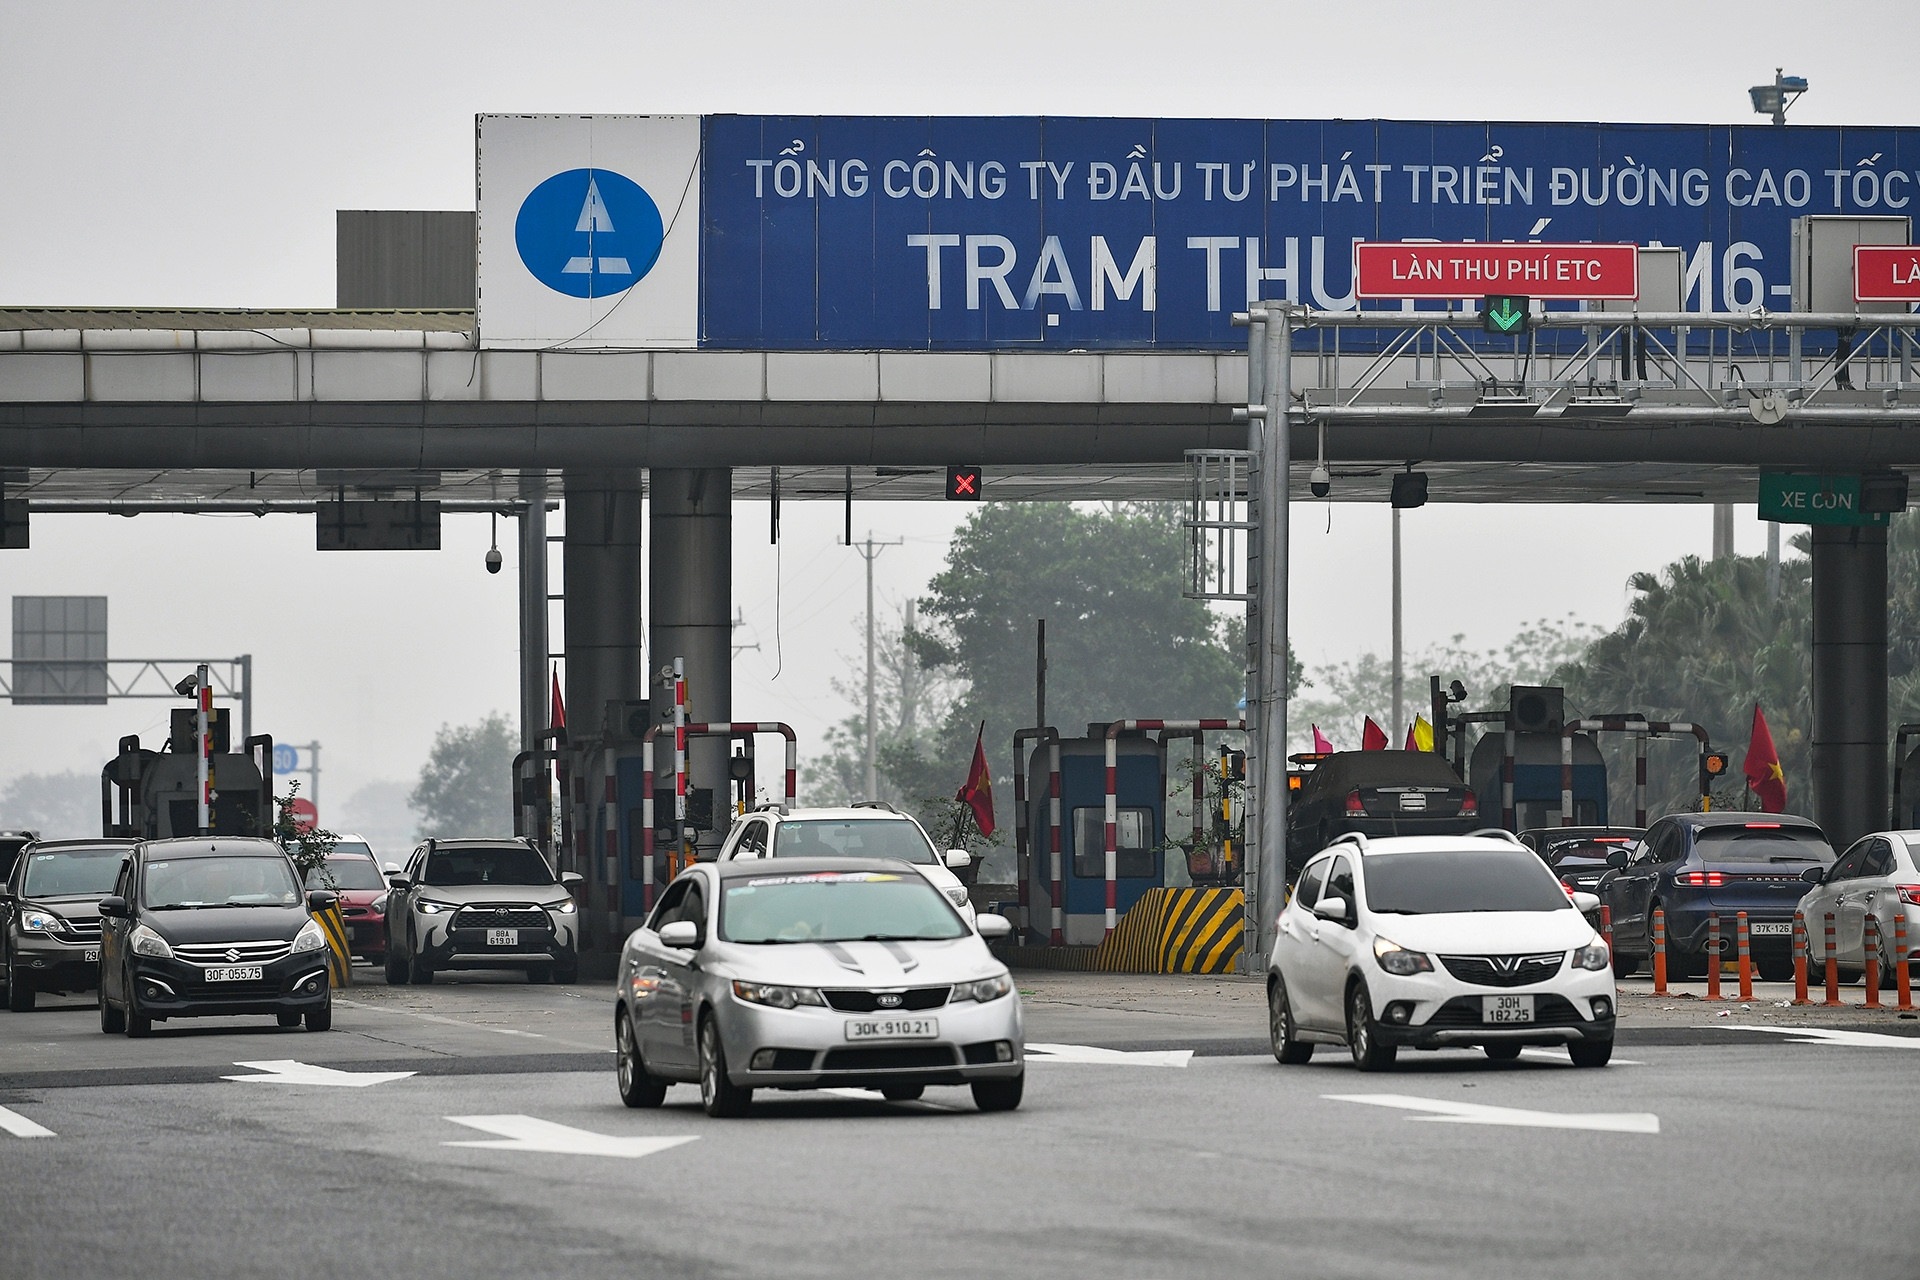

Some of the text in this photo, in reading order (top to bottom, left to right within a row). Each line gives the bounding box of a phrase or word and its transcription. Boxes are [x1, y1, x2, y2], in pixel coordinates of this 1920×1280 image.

[746, 139, 869, 198] TỔNG
[883, 148, 1007, 199] CÔNG
[1019, 161, 1074, 200] TY
[1087, 144, 1182, 201] ĐẦU
[1195, 159, 1256, 202] TƯ
[1271, 151, 1391, 203] PHÁT
[1402, 145, 1533, 206] TRIỂN
[1548, 155, 1710, 207] ĐƯỜNG
[1725, 168, 1811, 208] CAO
[1824, 153, 1910, 209] TỐC
[1392, 254, 1602, 281] LÀN THU PHÍ ETC
[907, 234, 1156, 327] TRẠM
[1187, 236, 1364, 312] THU
[1781, 491, 1852, 509] XE CON
[86, 951, 100, 961] 29
[206, 967, 261, 981] 30F-055.75
[1497, 996, 1520, 1008] 30H
[1490, 1009, 1529, 1021] 182.25
[855, 1021, 930, 1036] 30K-910.21
